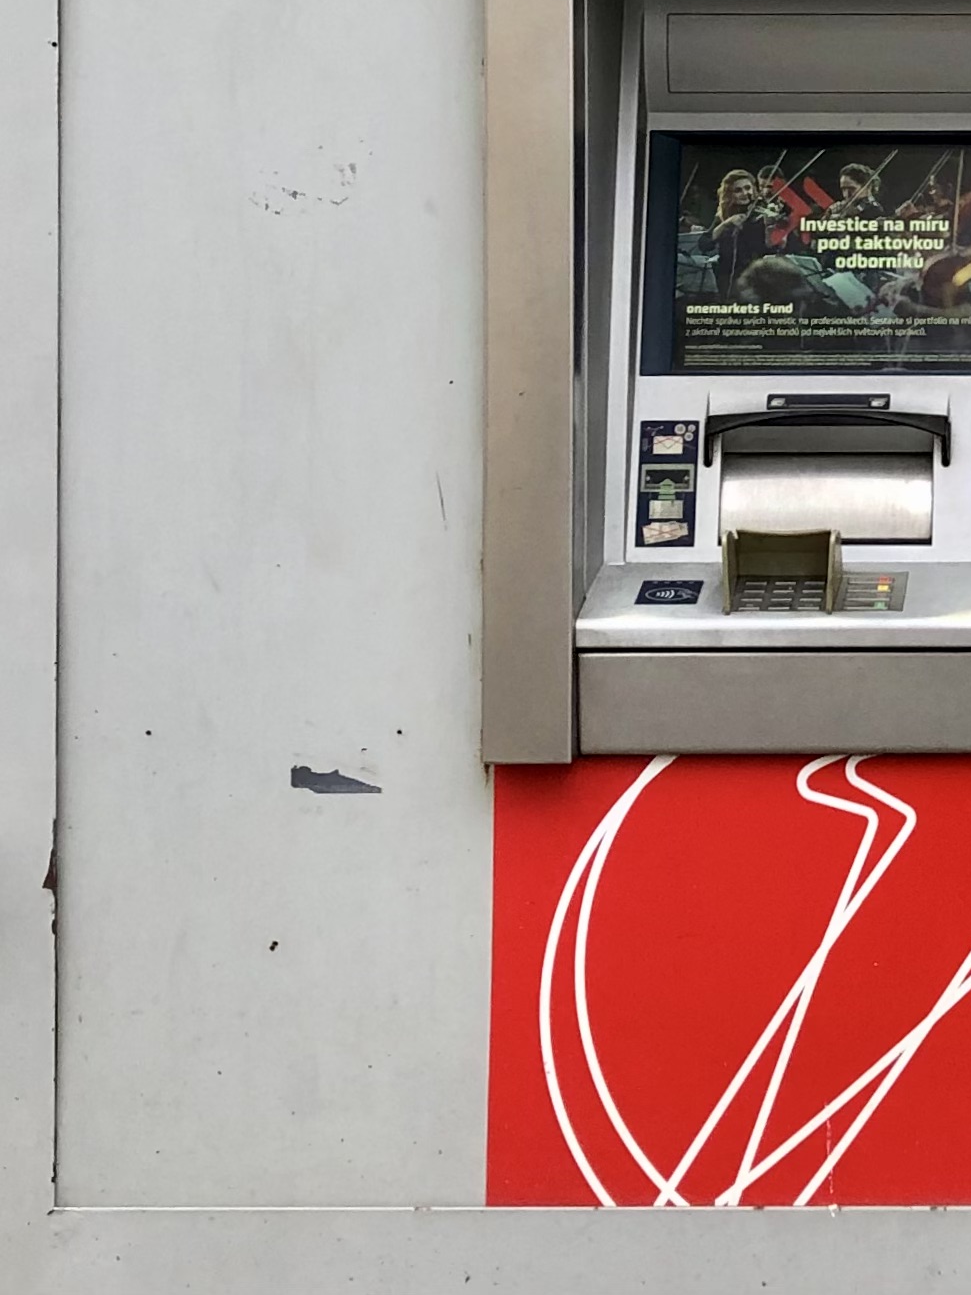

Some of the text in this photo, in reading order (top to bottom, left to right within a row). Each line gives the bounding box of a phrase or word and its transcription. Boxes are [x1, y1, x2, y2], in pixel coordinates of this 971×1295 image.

[800, 216, 950, 232] Investice na míru
[817, 235, 944, 253] pod taktovkou
[835, 251, 924, 269] odborníků
[686, 302, 794, 314] onemarkets Fund
